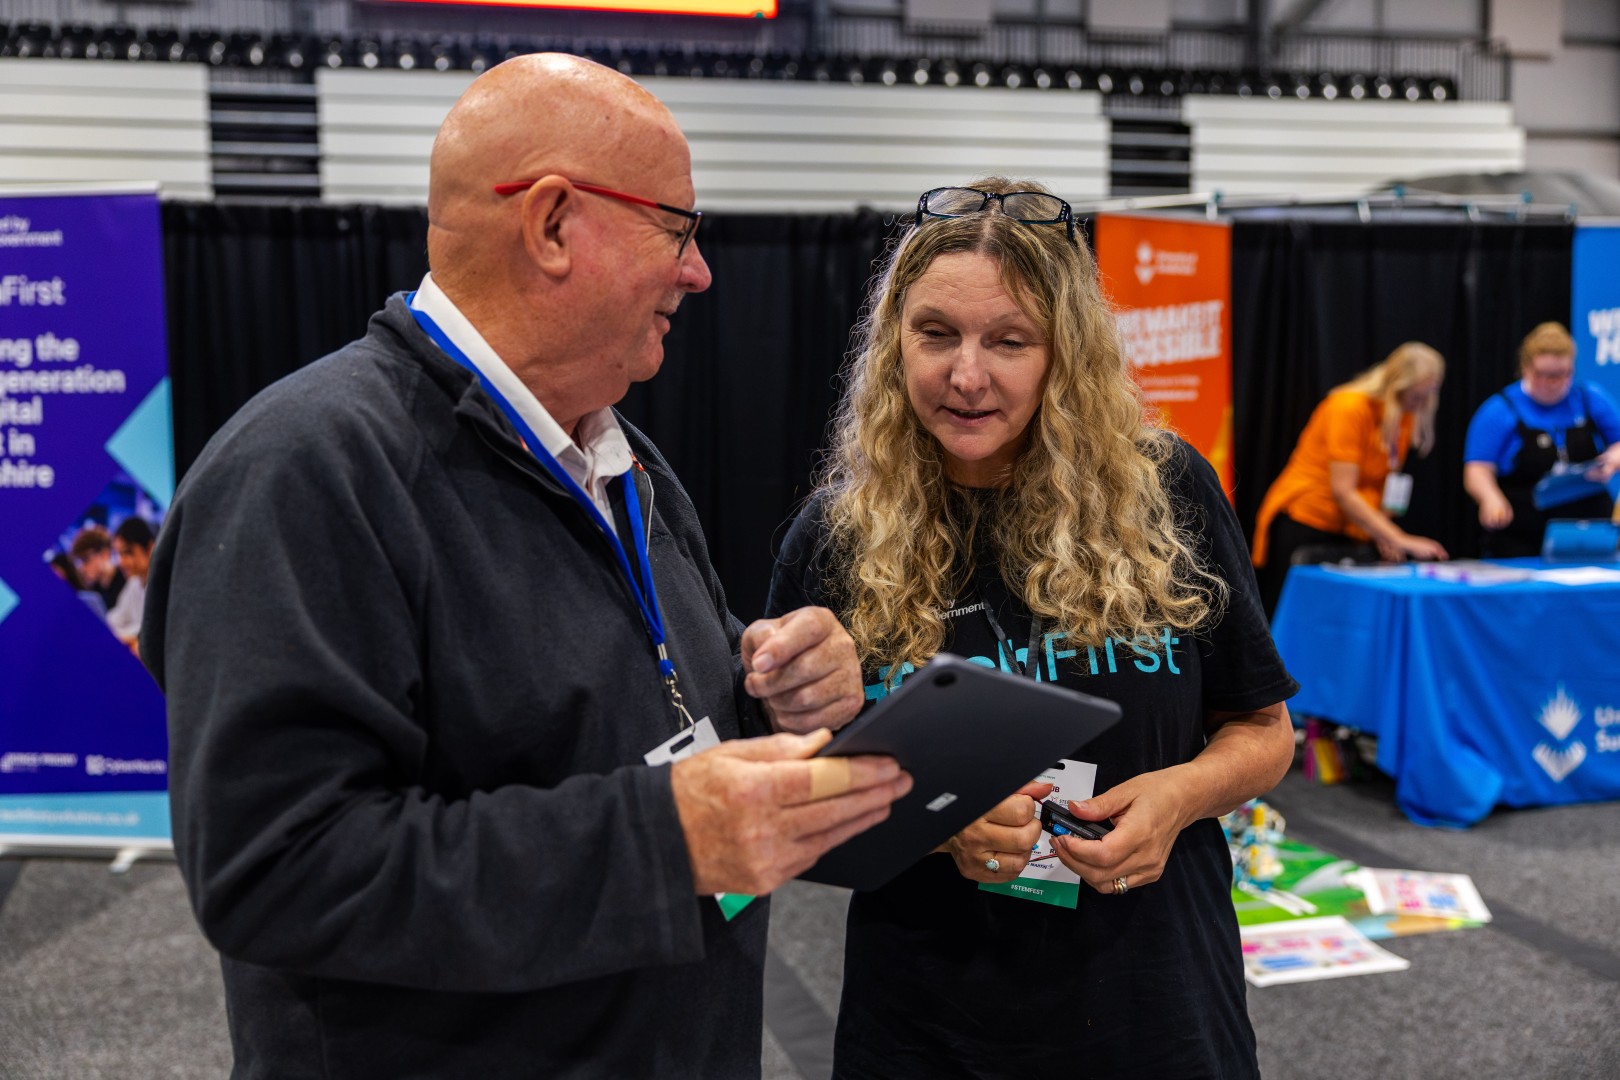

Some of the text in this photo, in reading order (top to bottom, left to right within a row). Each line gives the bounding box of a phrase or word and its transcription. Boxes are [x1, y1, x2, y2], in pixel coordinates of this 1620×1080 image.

[0, 274, 66, 306] First
[35, 331, 80, 362] the
[7, 427, 36, 457] in
[0, 458, 55, 488] hire
[1010, 884, 1044, 895] #STEMFEST
